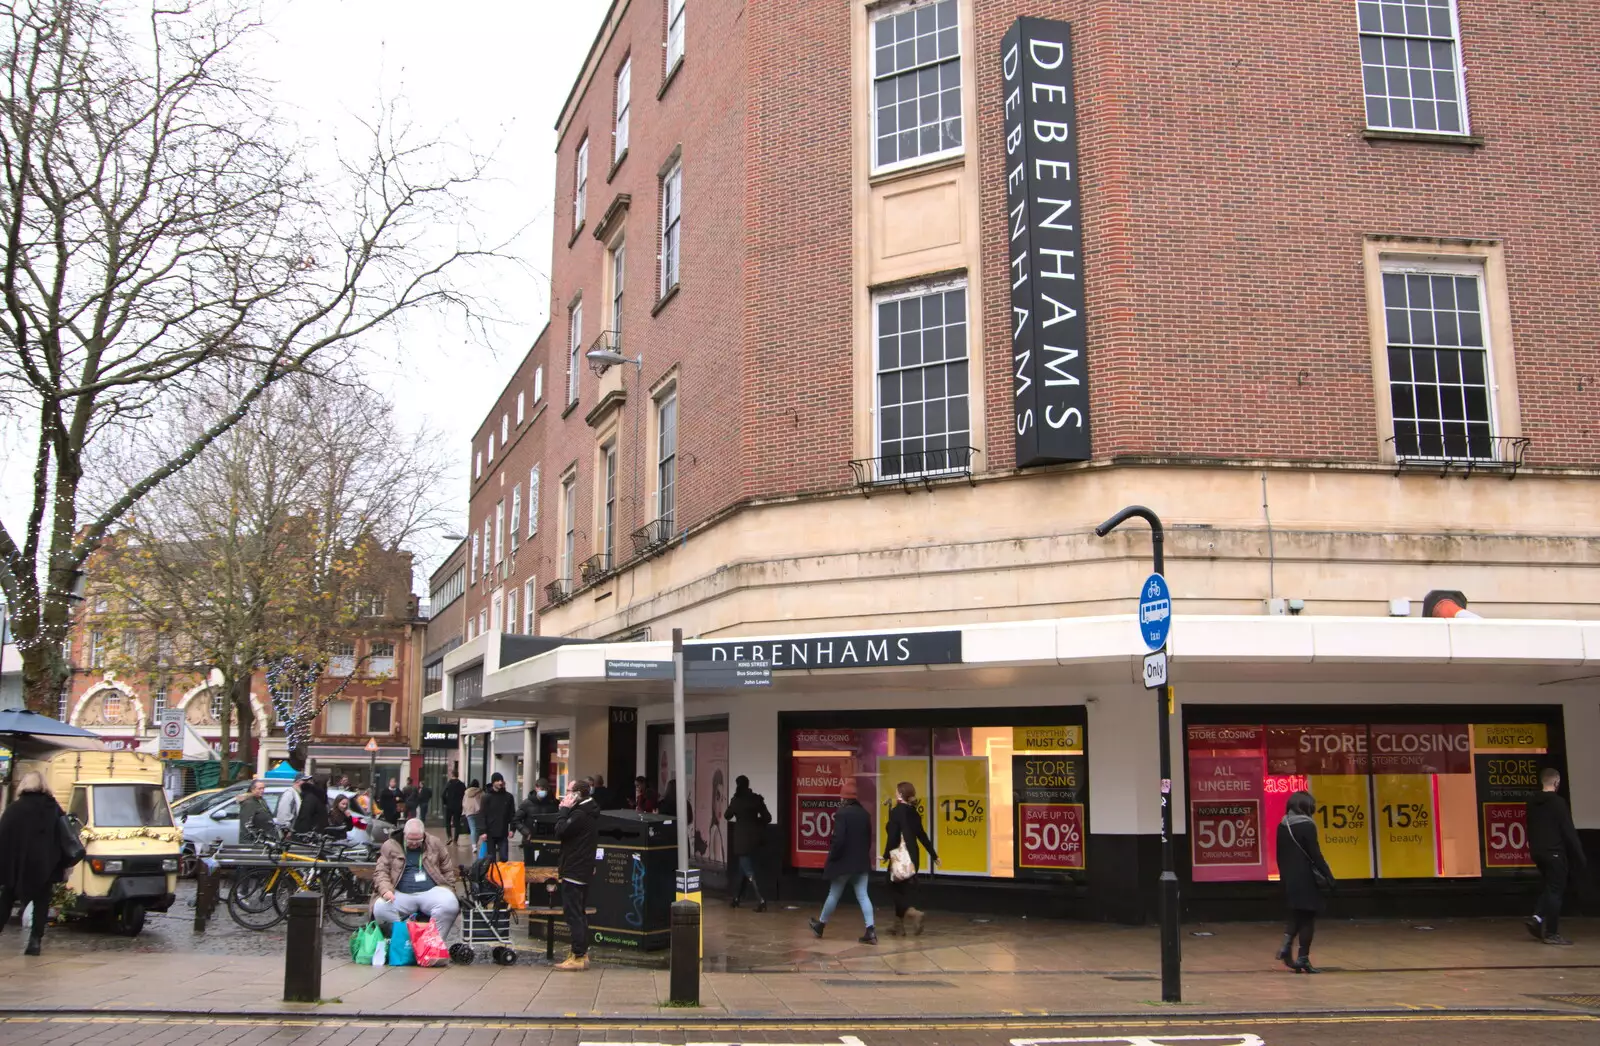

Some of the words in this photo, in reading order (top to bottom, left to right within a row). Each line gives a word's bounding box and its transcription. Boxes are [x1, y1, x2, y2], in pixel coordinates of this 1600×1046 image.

[1029, 38, 1083, 429] DEBENHAMS
[1003, 43, 1033, 436] DEBENHAMS
[1150, 630, 1160, 640] taxi
[711, 637, 910, 666] DEBENHAMS
[1147, 662, 1164, 678] Only
[1190, 731, 1216, 739] STORE
[1218, 731, 1255, 739] CLOSING
[1487, 736, 1515, 744] MUST
[1518, 736, 1534, 744] GO
[1026, 738, 1054, 747] MUST
[1057, 738, 1073, 747] GO
[1300, 734, 1367, 752] STORE
[1376, 733, 1468, 752] CLOSING
[1348, 757, 1367, 765] THIS
[1372, 756, 1398, 765] STORE
[1401, 756, 1425, 765] ONLY
[816, 764, 832, 773] ALL
[1025, 761, 1075, 775] STORE
[1214, 766, 1234, 776] ALL
[1488, 760, 1536, 774] STORE
[1025, 776, 1076, 786] CLOSING
[1488, 775, 1537, 785] CLOSING
[1198, 781, 1251, 791] LINGERIE
[941, 800, 983, 822] 15%
[1027, 811, 1048, 819] SAVE
[1063, 812, 1075, 820] TO
[1317, 805, 1364, 828] 15%
[1382, 804, 1428, 828] 15%
[1491, 810, 1512, 818] SAVE
[800, 812, 836, 837] 50
[1348, 821, 1364, 829] OFF
[1412, 820, 1428, 828] OFF
[947, 826, 977, 838] beauty
[1024, 823, 1079, 850] 50%
[1198, 819, 1255, 848] 50%
[1490, 822, 1529, 849] 50
[1236, 838, 1255, 847] OFF
[1325, 834, 1358, 845] beauty
[1390, 832, 1422, 844] beauty
[1060, 842, 1079, 851] OFF
